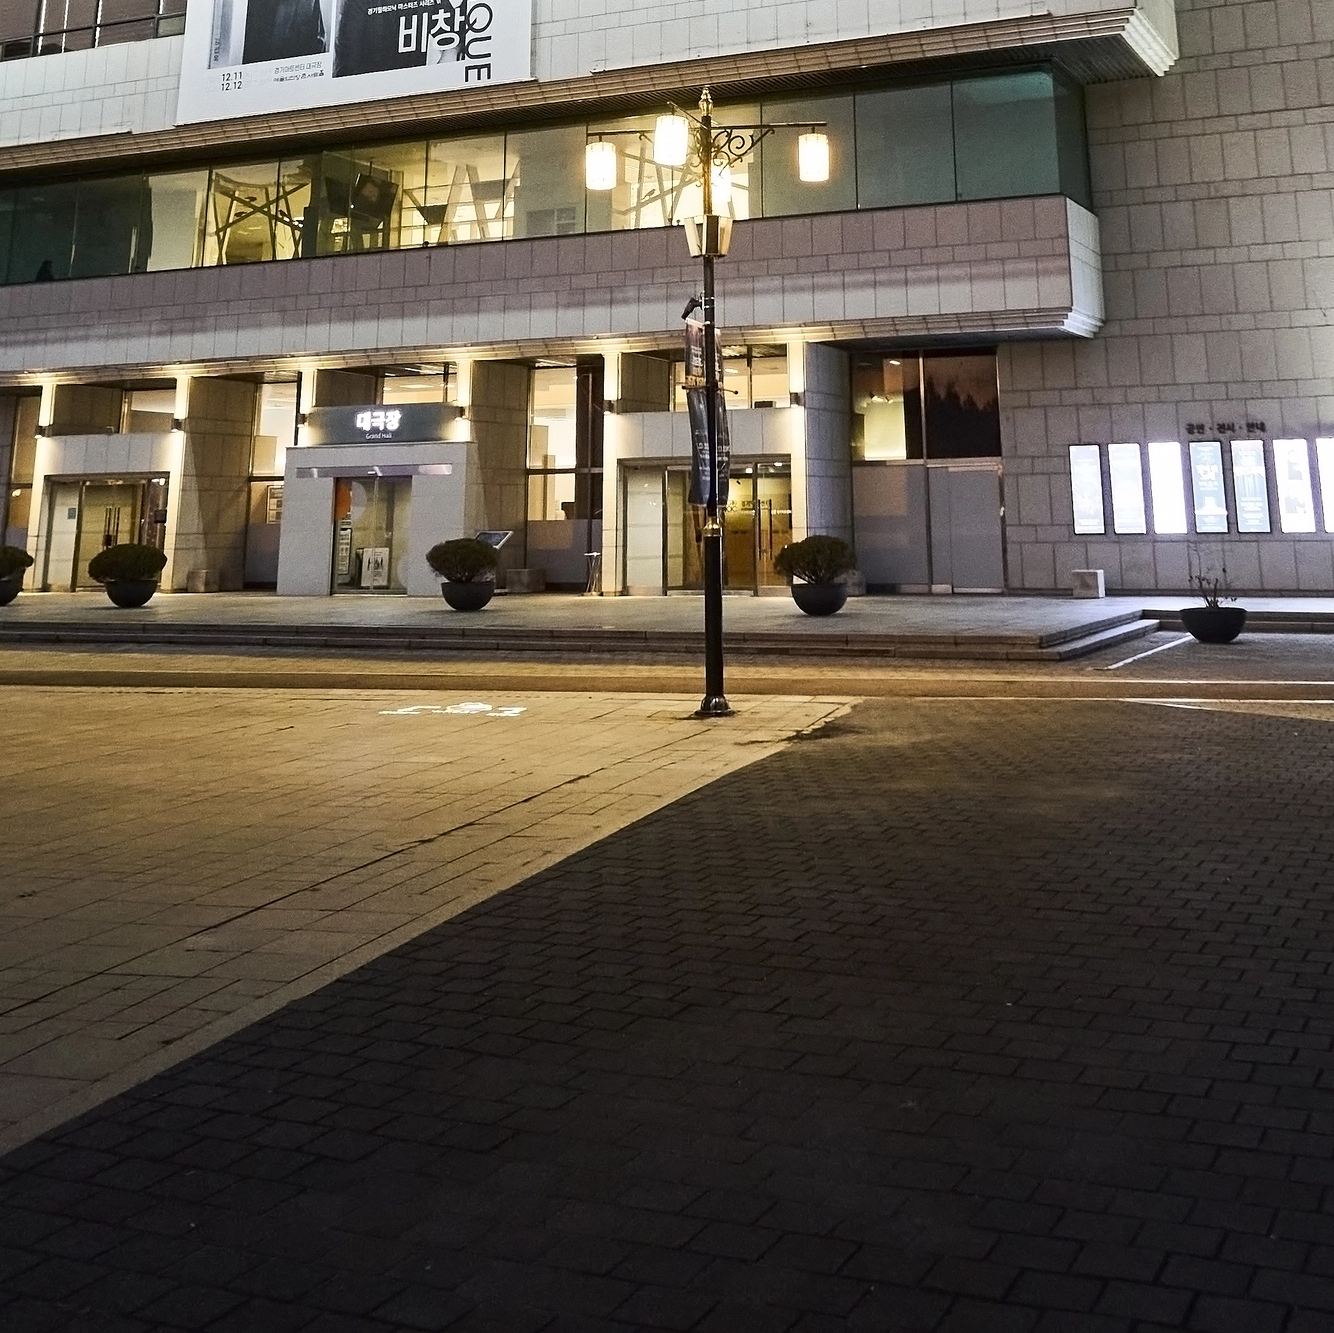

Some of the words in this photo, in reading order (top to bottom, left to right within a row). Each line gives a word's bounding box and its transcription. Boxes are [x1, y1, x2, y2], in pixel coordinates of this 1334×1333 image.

[367, 4, 397, 15] 경기필하모닉
[397, 0, 419, 11] 마스터즈
[398, 8, 466, 54] 비창
[274, 63, 305, 75] 경기아트센터
[306, 61, 323, 71] 대극장
[221, 71, 243, 82] 12.11
[221, 81, 243, 91] 12.12
[356, 410, 402, 432] 대극장
[365, 432, 381, 440] Grand
